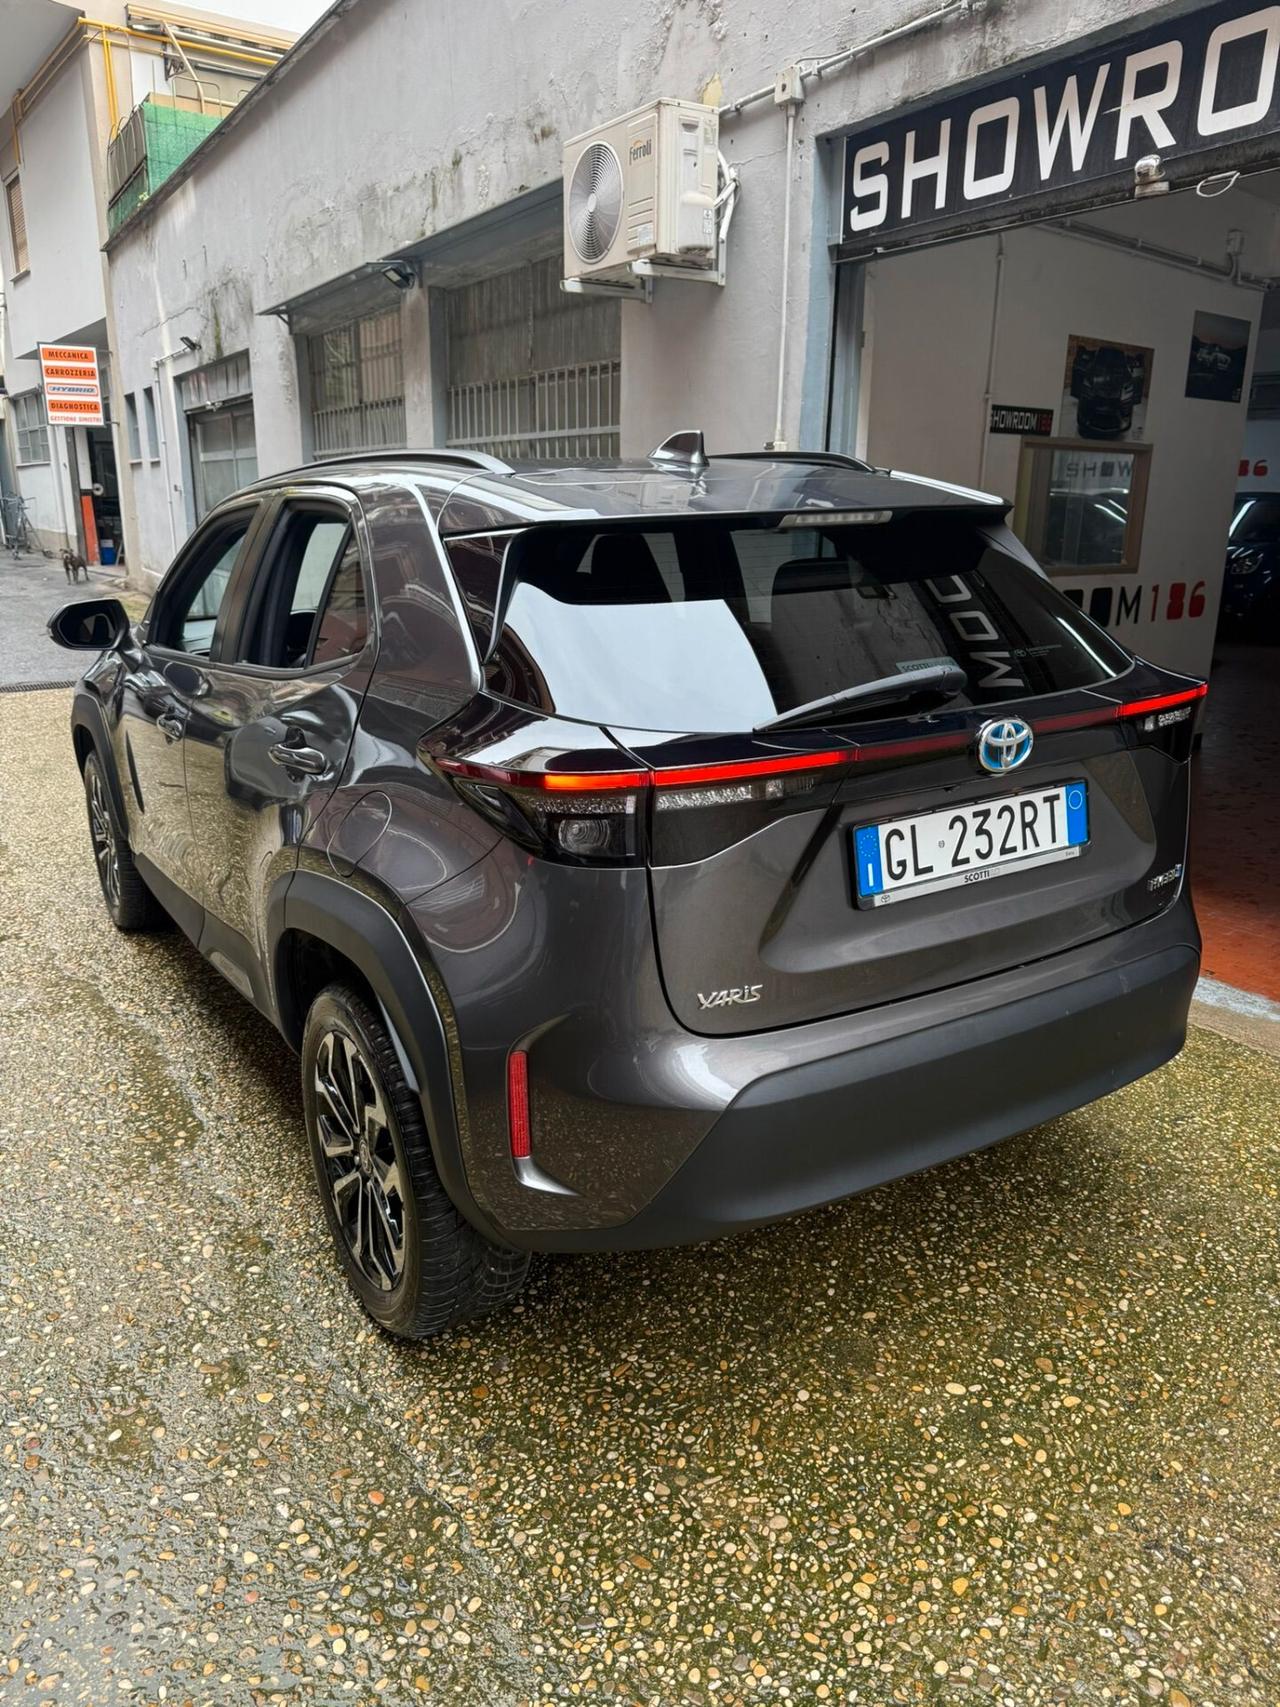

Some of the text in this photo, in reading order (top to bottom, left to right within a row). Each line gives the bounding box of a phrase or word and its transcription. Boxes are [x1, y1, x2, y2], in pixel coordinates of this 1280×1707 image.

[850, 5, 1280, 232] SHOWRO
[629, 138, 652, 165] Ferroli
[48, 351, 89, 360] MECCANICA
[45, 367, 96, 377] CARROZZERIA
[50, 385, 96, 393] HYBRID
[50, 403, 99, 411] DIAGNOSTICA
[885, 793, 1061, 882] GL 232RT
[963, 869, 990, 884] SCOTTI
